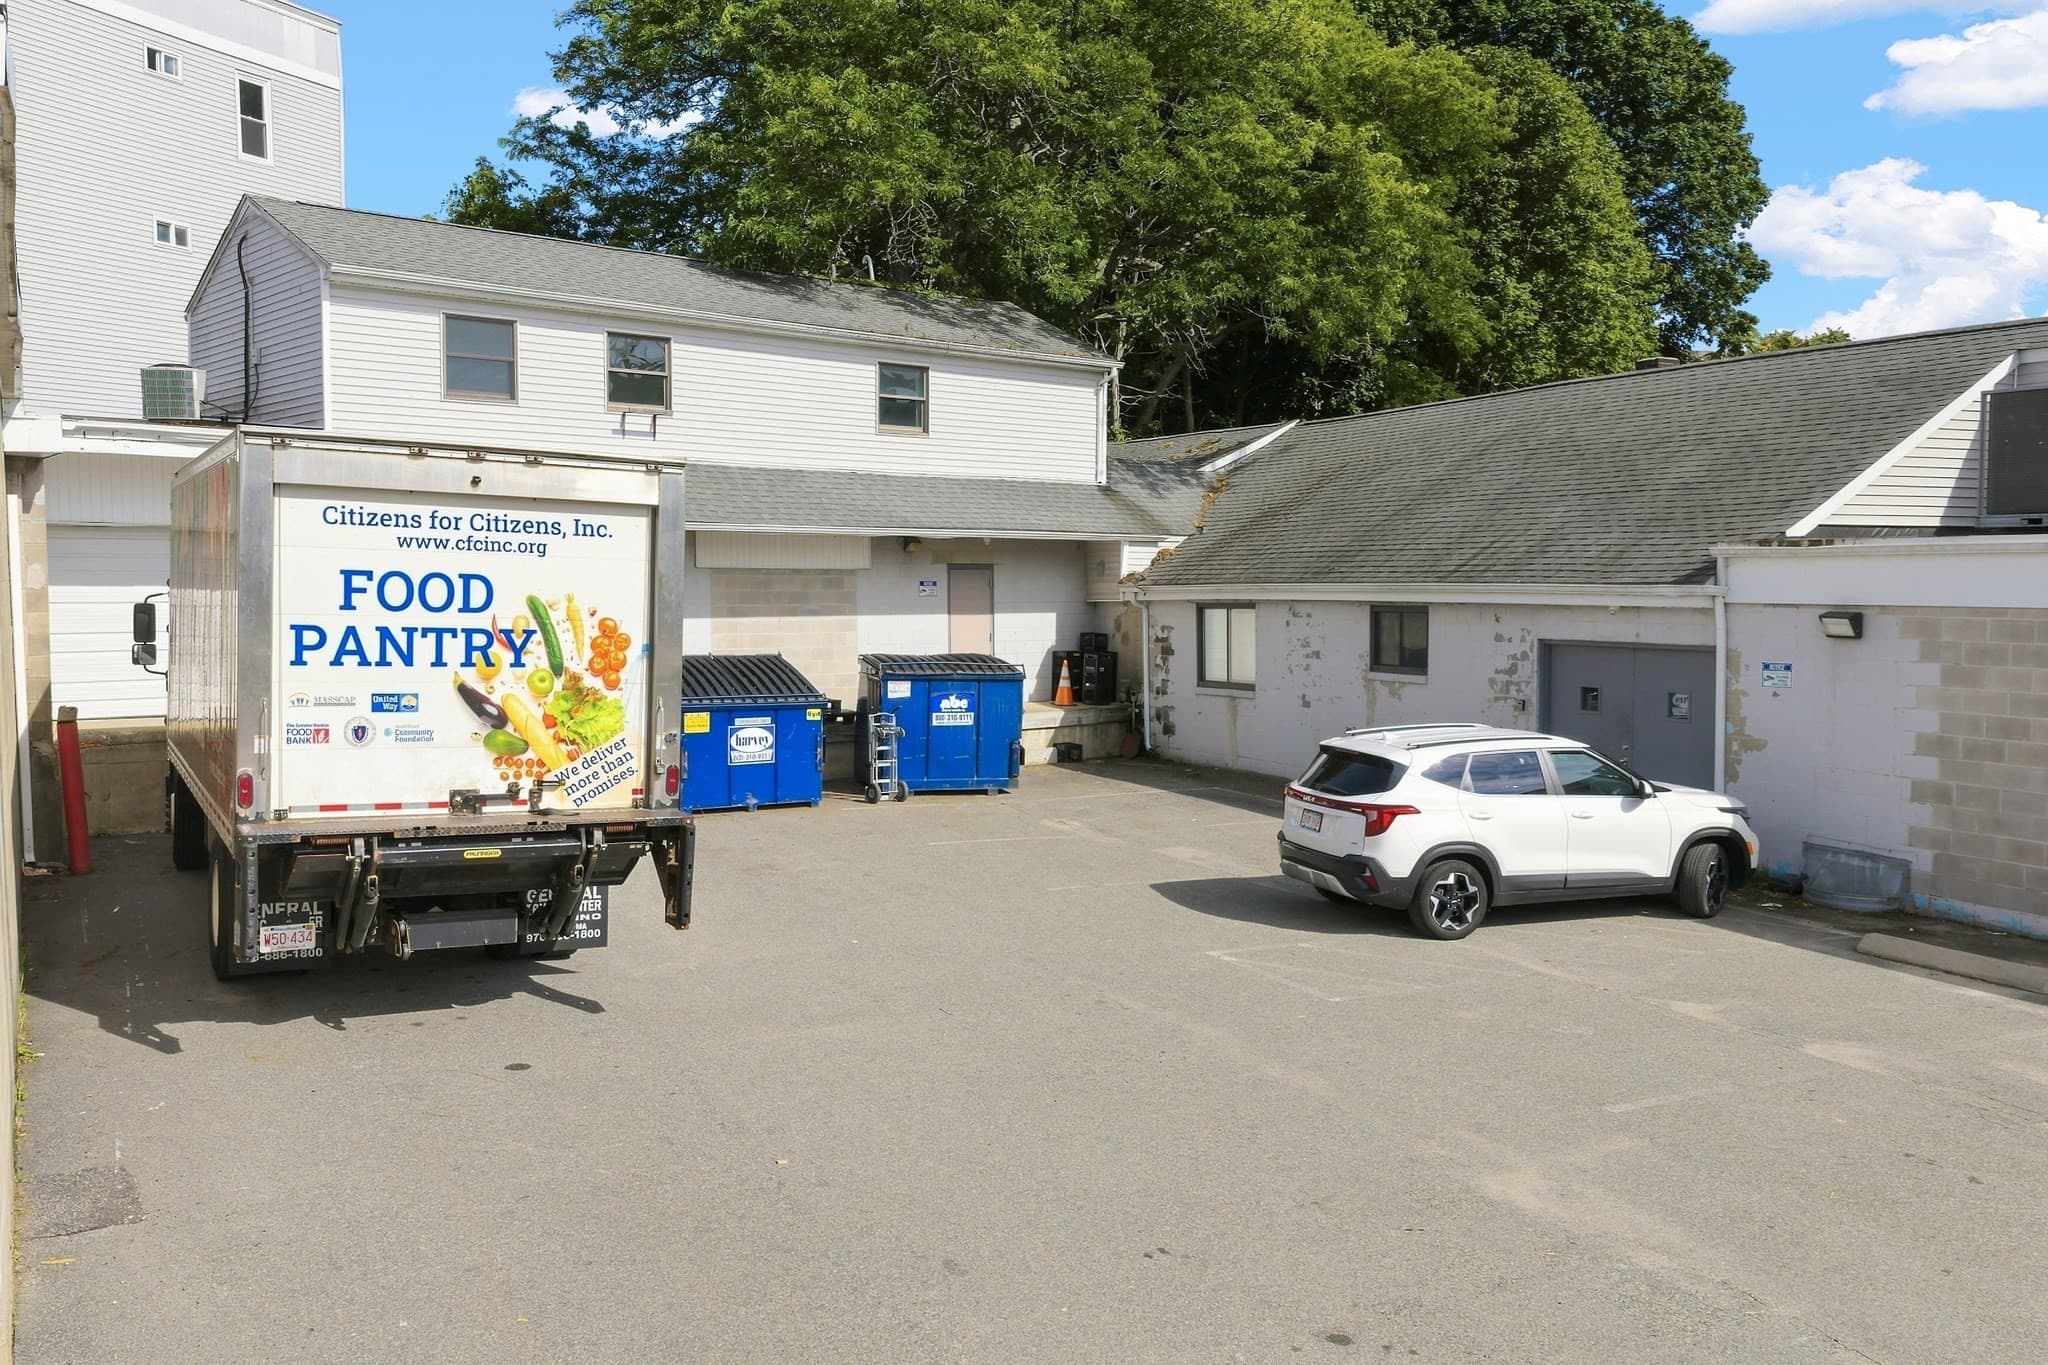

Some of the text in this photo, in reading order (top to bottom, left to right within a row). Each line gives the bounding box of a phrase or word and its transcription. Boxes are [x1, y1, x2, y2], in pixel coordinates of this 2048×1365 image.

[322, 505, 614, 539] Citizens for Citizens, Inc.
[396, 535, 548, 558] www.cfcinc.org
[338, 569, 494, 614] FOOD
[289, 624, 538, 669] PANTRY
[372, 695, 399, 703] United
[382, 703, 399, 712] Way
[286, 728, 313, 736] FOOD
[394, 728, 434, 737] Community
[735, 733, 769, 748] harvey
[554, 737, 628, 782] We deliver
[563, 751, 635, 797] more than
[572, 765, 639, 808] promises.
